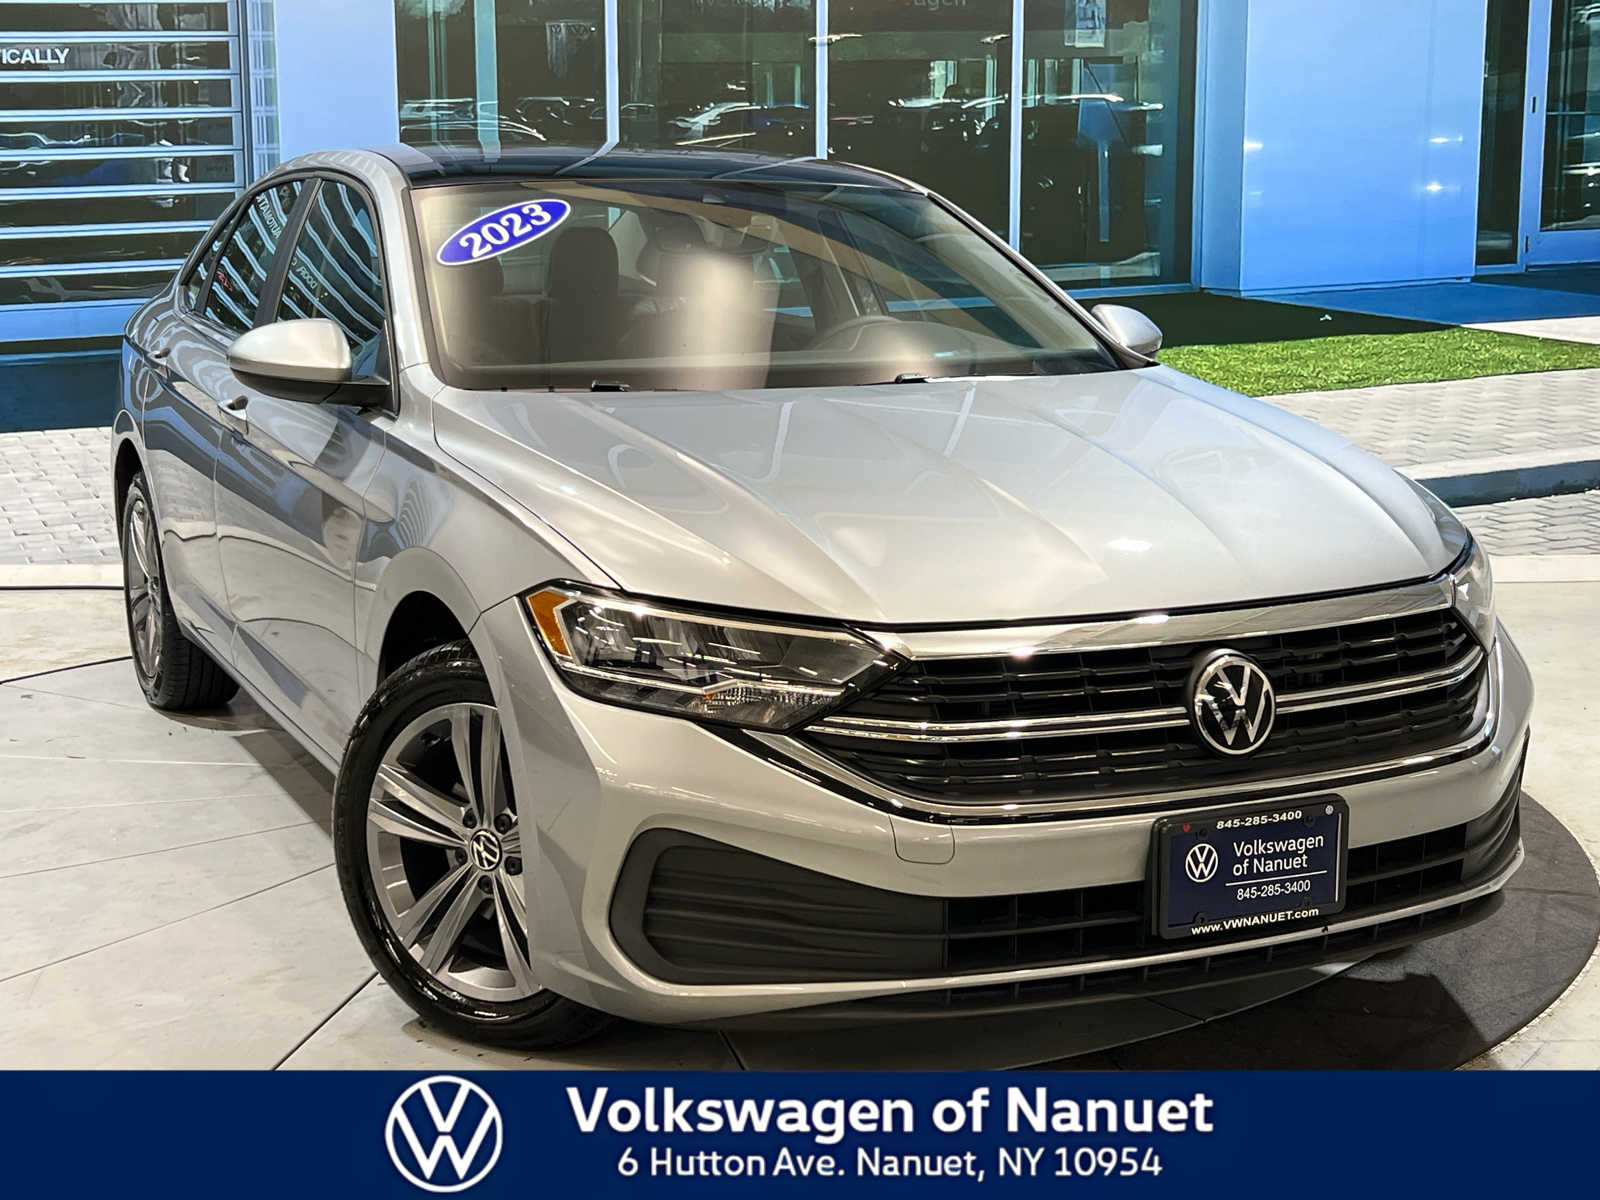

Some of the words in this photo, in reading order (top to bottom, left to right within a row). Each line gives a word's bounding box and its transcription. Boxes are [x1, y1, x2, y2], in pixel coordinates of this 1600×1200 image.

[0, 48, 70, 64] ICALLY
[459, 203, 551, 258] 2023
[1216, 810, 1302, 830] 845-285-3400
[1233, 835, 1324, 857] Volkswagen
[1233, 861, 1250, 876] of
[1253, 855, 1308, 873] Nanuet
[1236, 880, 1311, 901] 845-285-3400
[1191, 908, 1319, 935] www.VWNANUET.com
